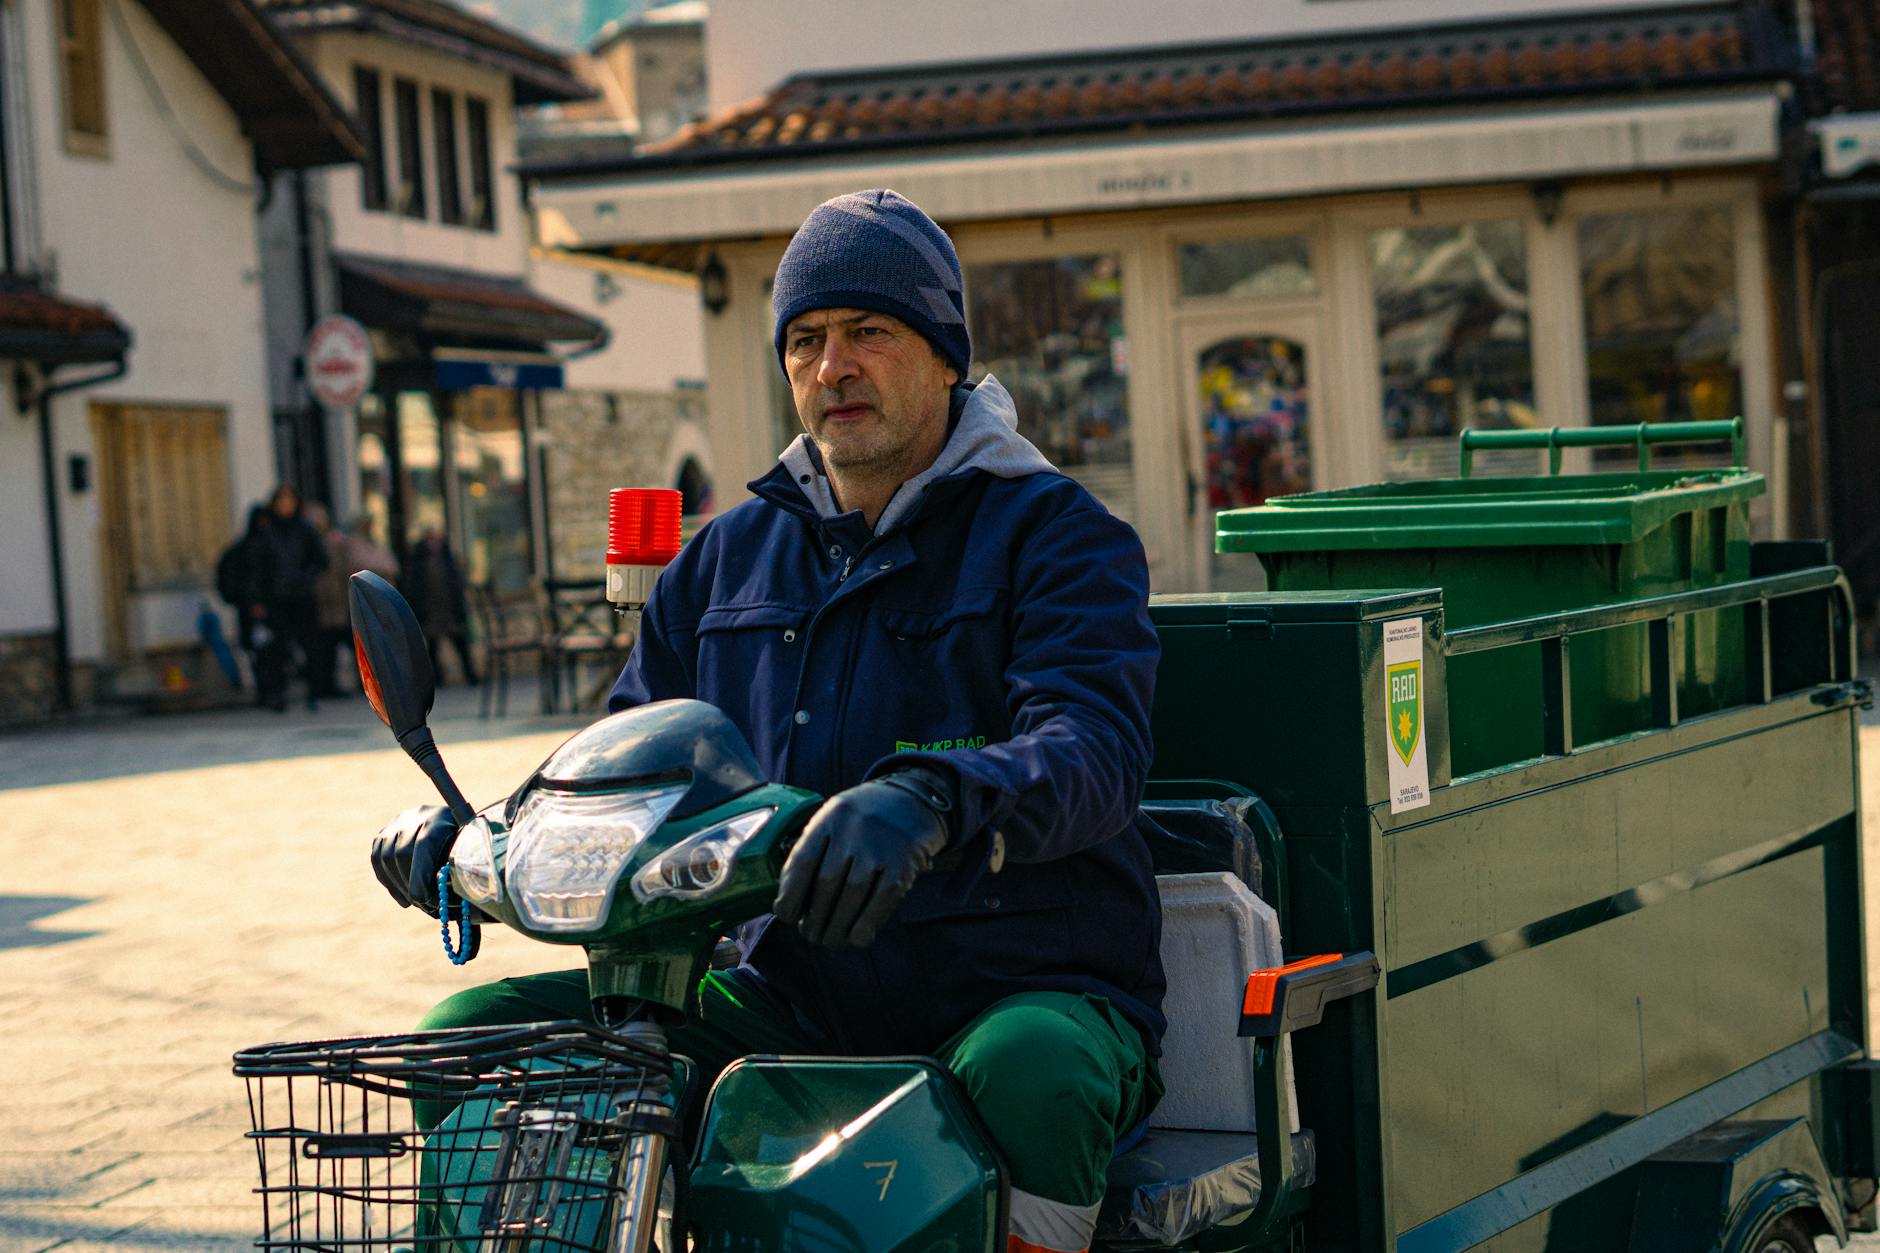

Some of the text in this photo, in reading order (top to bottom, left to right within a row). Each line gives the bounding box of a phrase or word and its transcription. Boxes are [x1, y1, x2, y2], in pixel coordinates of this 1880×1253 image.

[1392, 674, 1416, 703] RAD
[956, 736, 985, 751] RAD
[864, 1160, 898, 1201] 7
